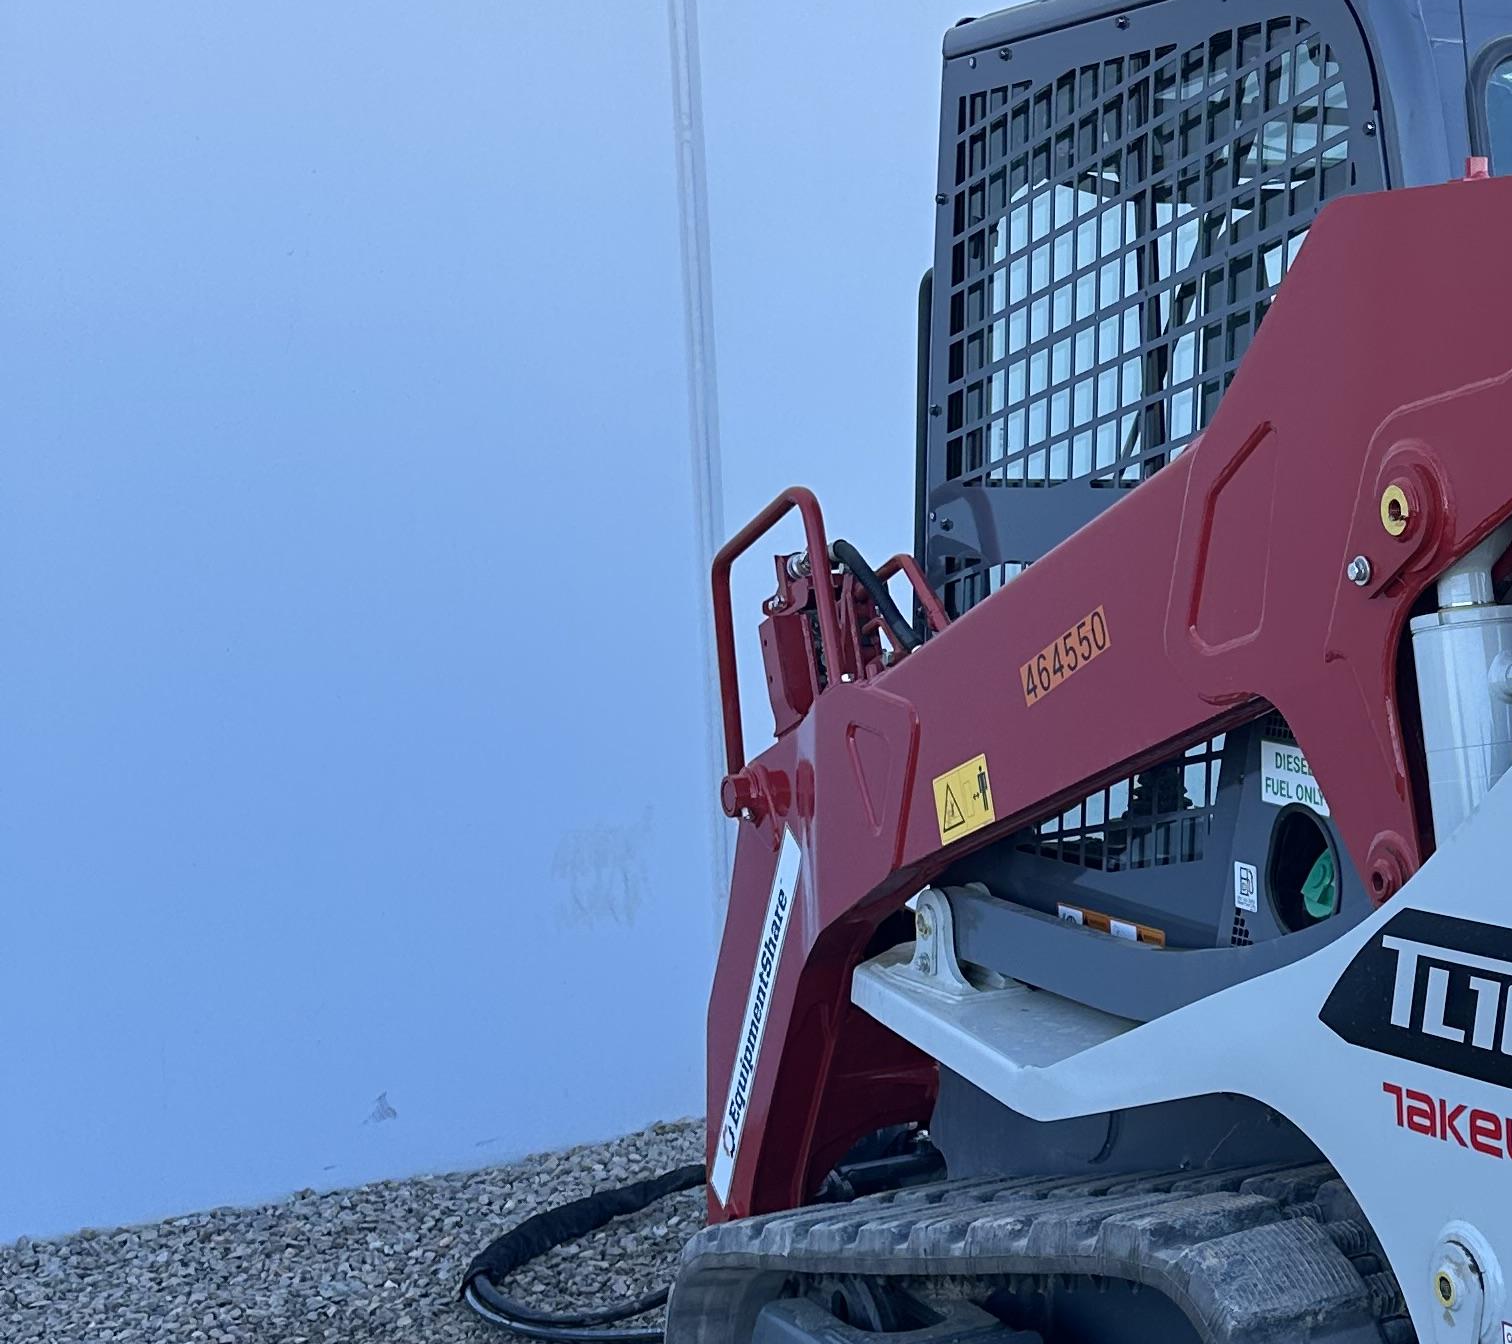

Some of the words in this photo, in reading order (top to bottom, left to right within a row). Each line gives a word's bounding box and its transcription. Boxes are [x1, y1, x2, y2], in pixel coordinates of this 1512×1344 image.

[1027, 611, 1106, 698] 464550
[1265, 776, 1293, 799] FUEL
[1296, 783, 1323, 806] ONLY
[728, 888, 788, 1130] EquipmentShare
